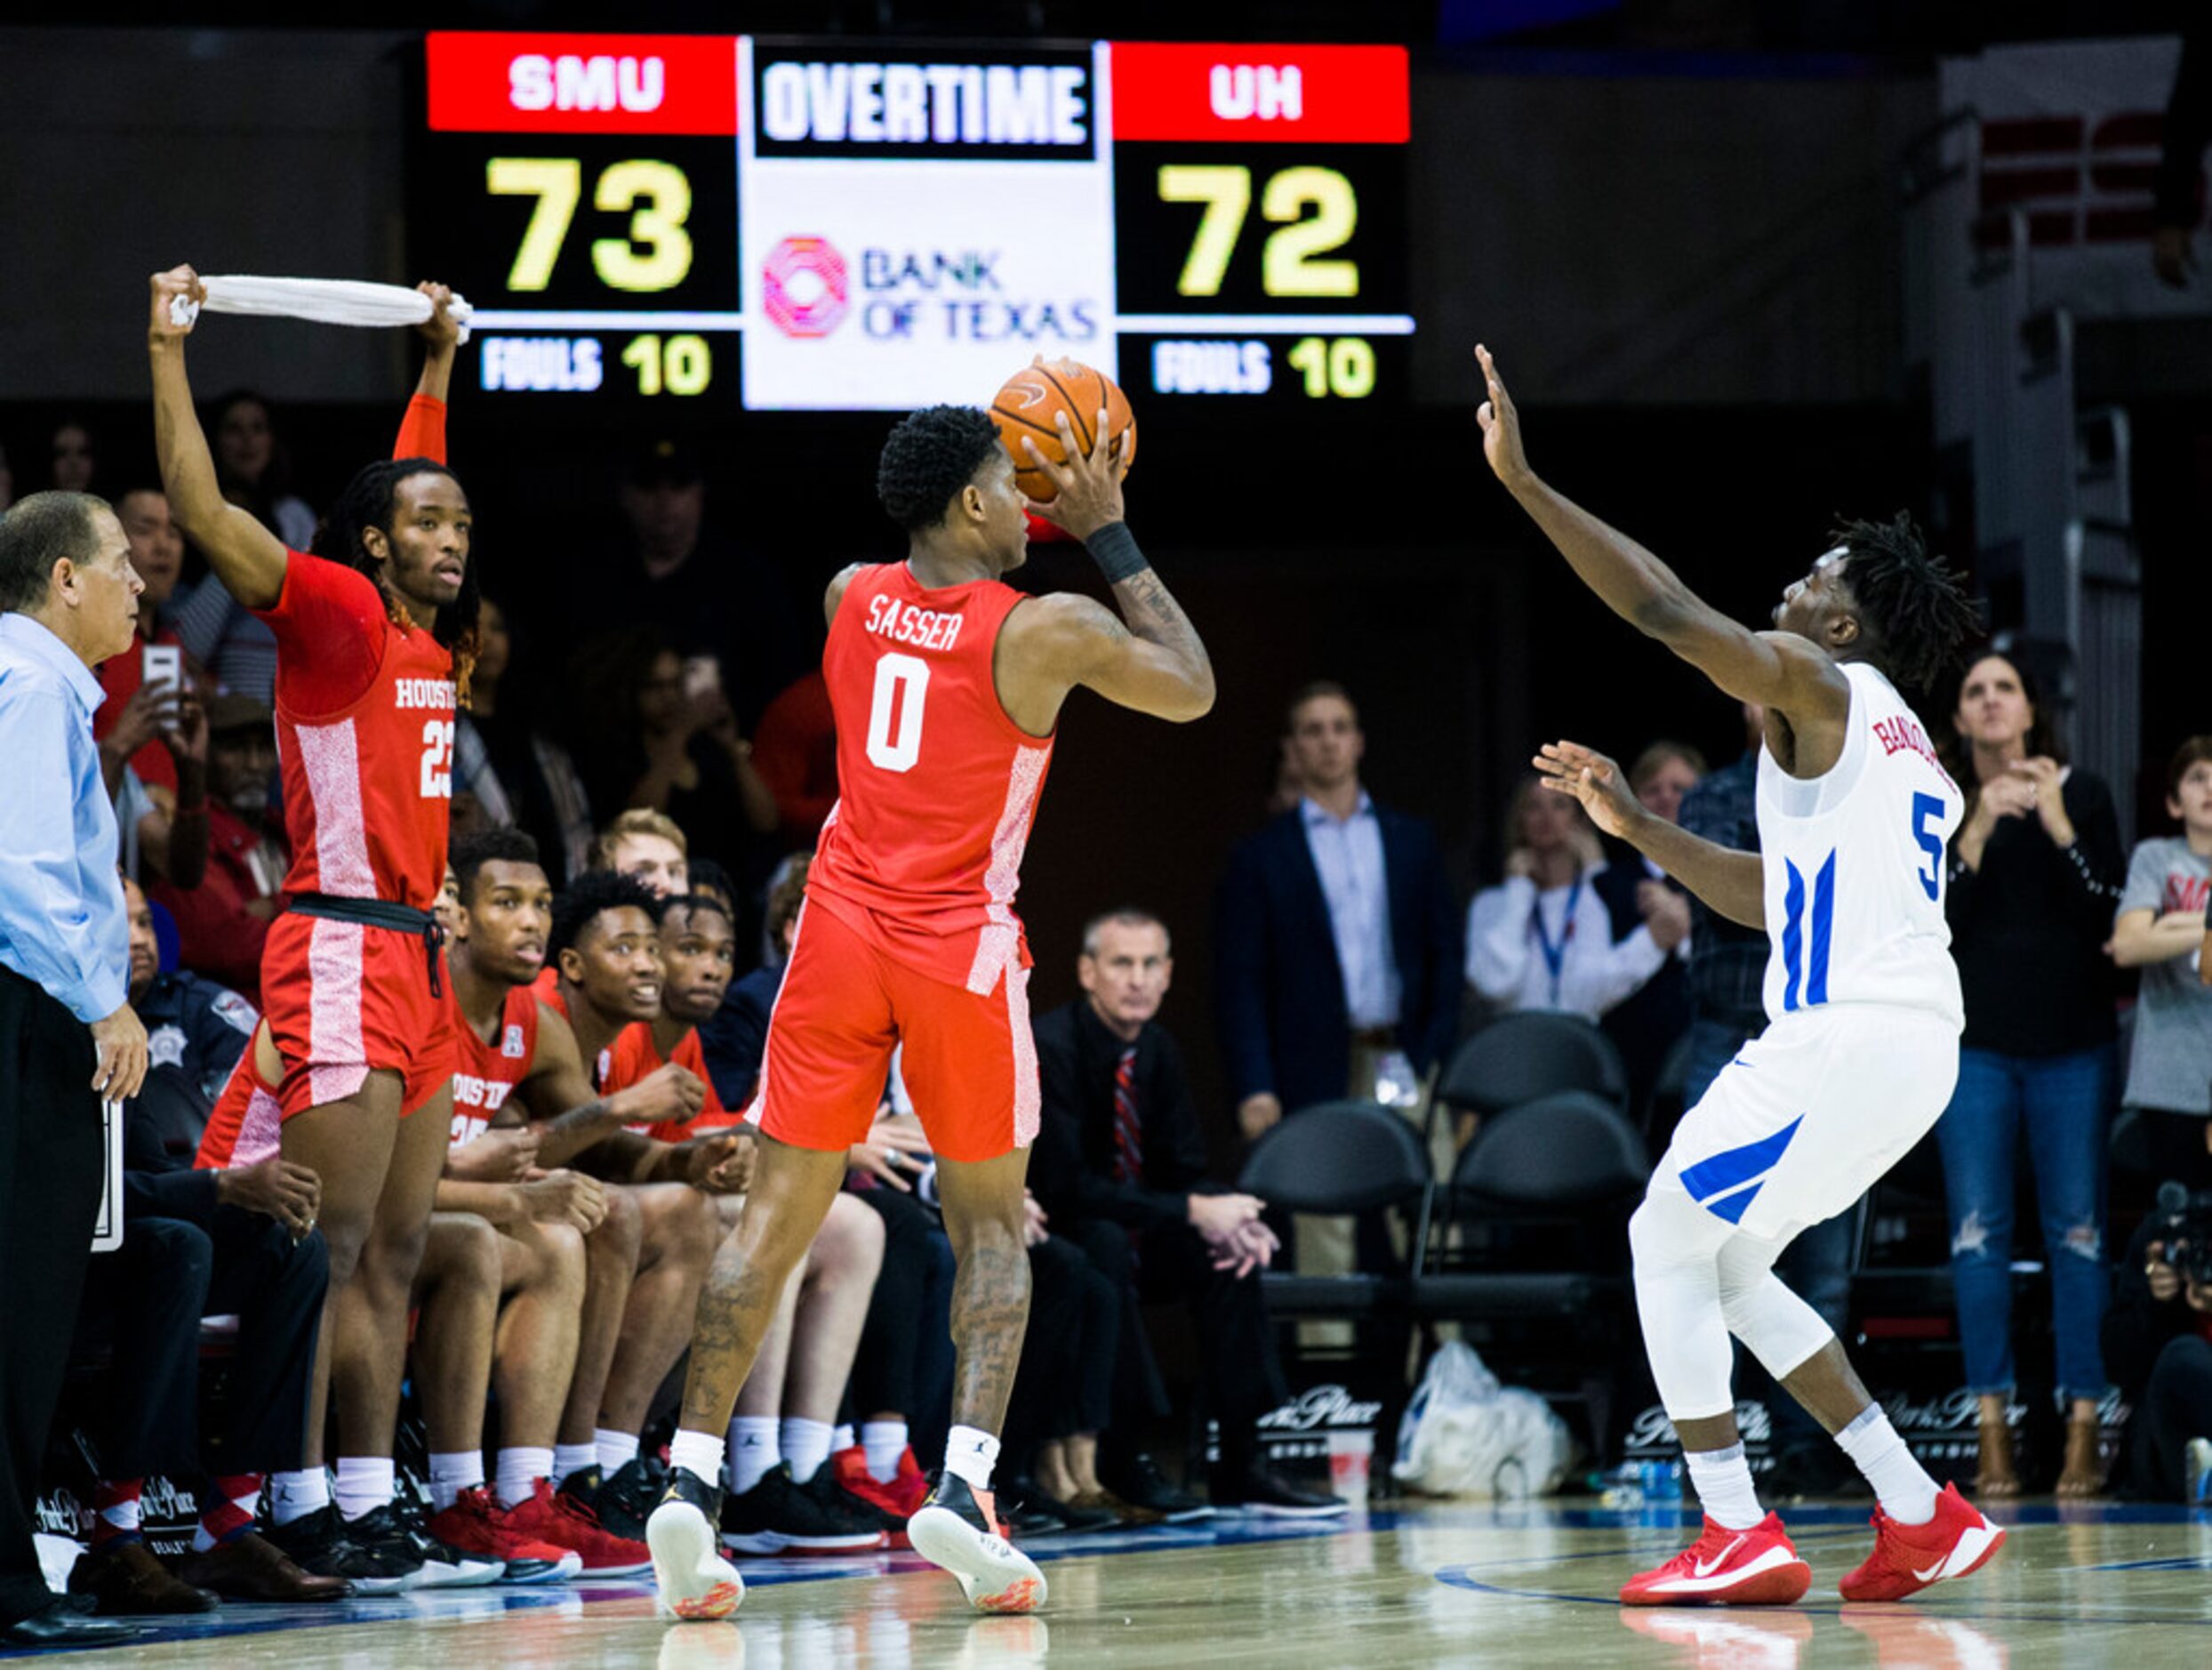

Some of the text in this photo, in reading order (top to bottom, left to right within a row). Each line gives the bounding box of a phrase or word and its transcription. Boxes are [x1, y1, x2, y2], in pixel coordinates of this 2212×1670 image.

[509, 54, 665, 112] SMU
[762, 61, 1087, 145] OVERTIME
[1209, 64, 1302, 120] UH
[486, 157, 693, 293] 73
[1158, 165, 1360, 297] 72
[862, 248, 1003, 291] BANK
[862, 299, 1098, 341] OF TEXAS
[481, 333, 711, 396] FOULS 10
[1151, 336, 1377, 398] FOULS 10
[865, 593, 964, 651] SASSER
[866, 652, 931, 774] 0
[1911, 791, 1945, 903] 5
